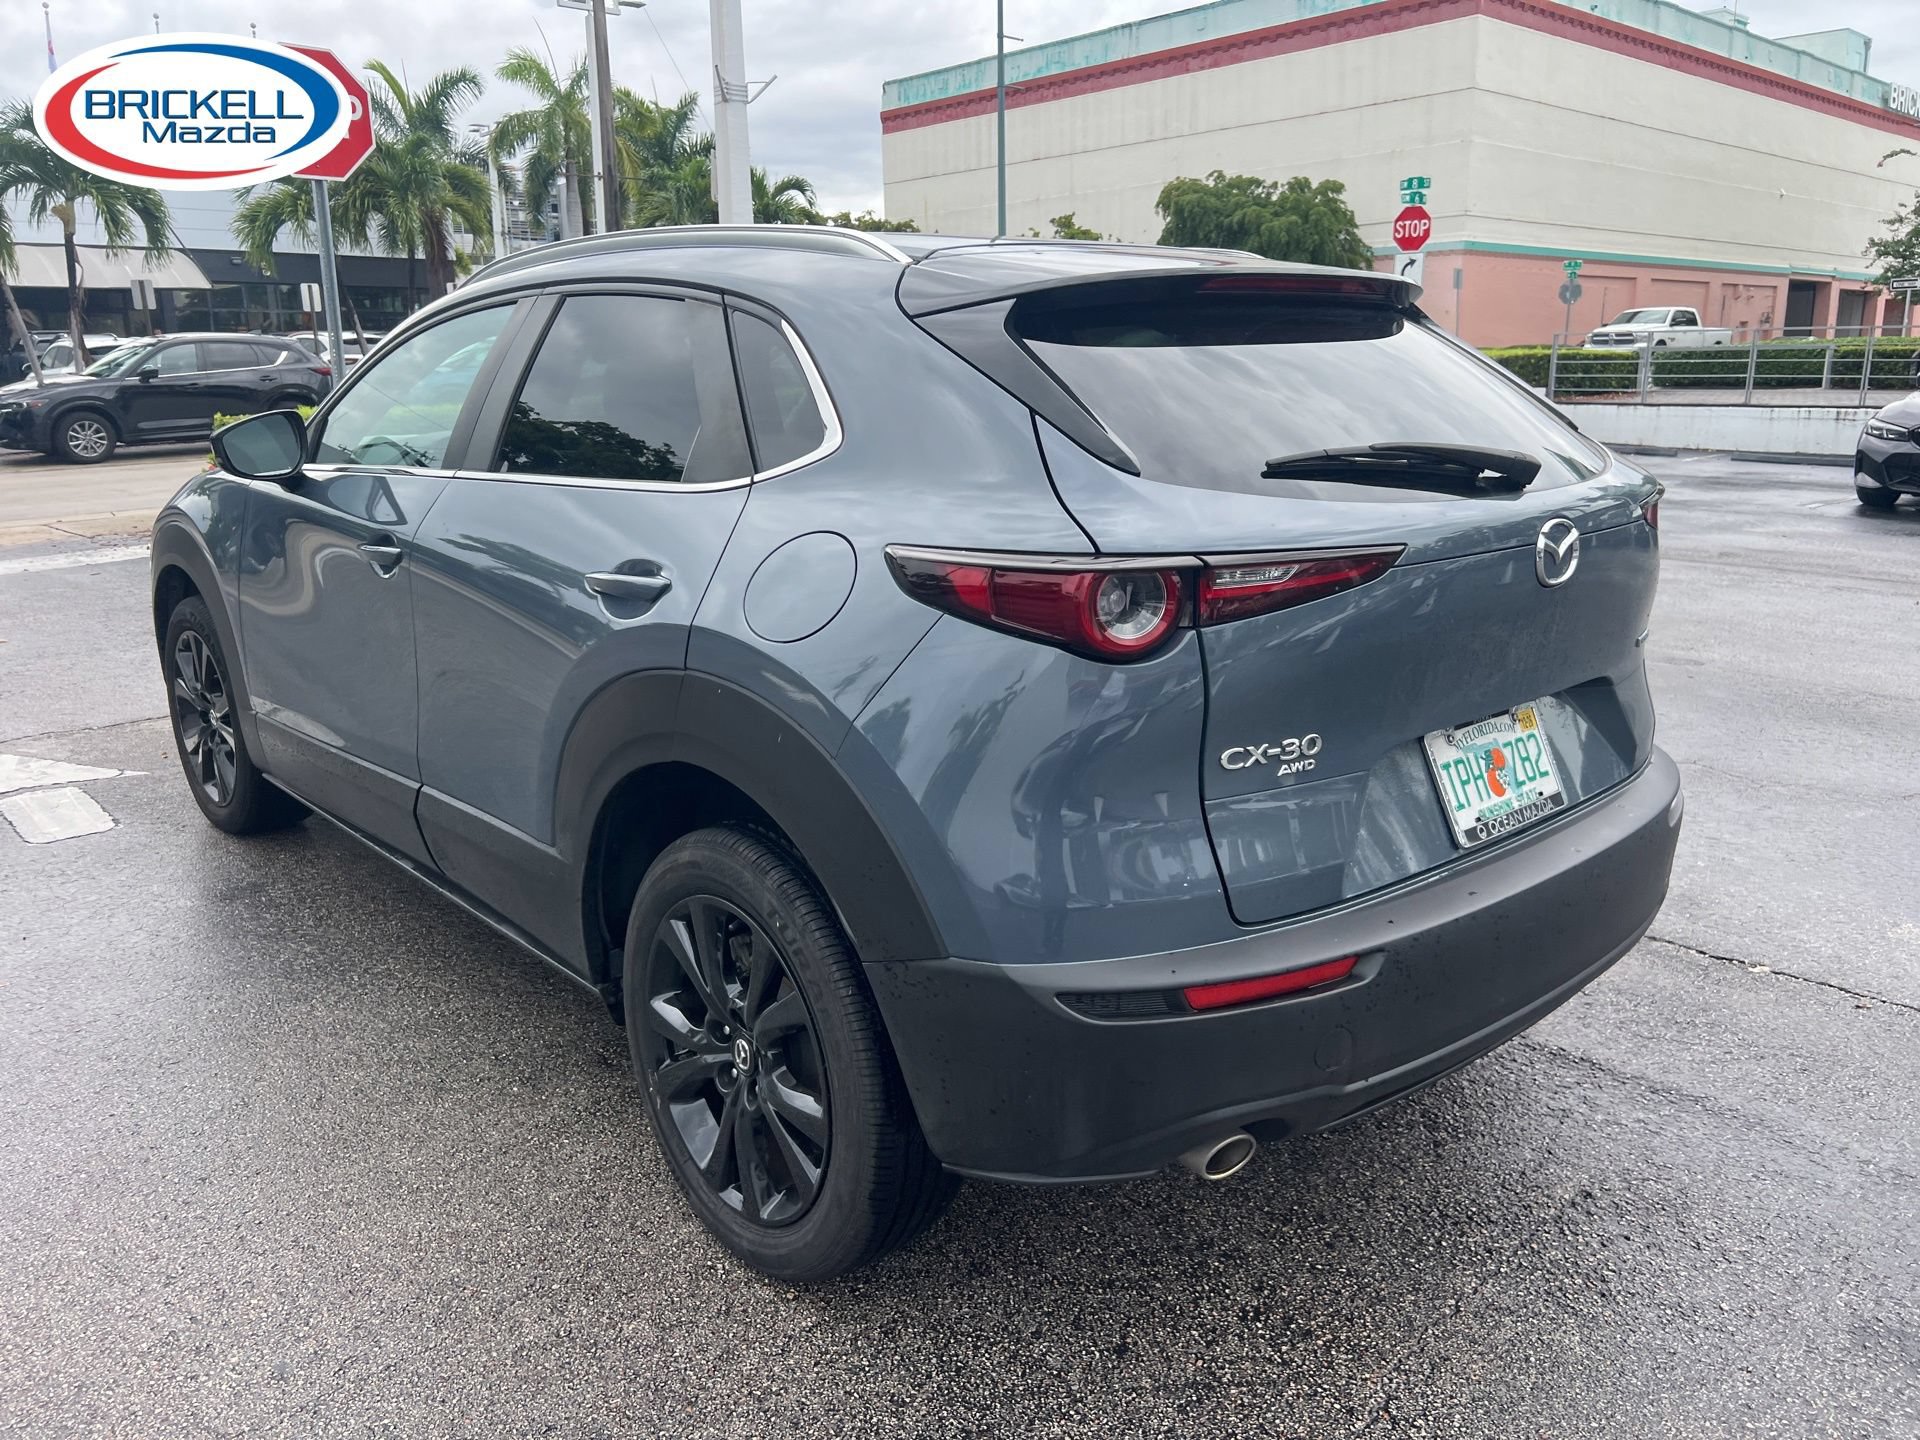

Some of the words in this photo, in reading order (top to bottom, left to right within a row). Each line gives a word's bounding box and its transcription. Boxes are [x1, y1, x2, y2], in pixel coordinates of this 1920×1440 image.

[1395, 219, 1429, 238] STOP
[1220, 733, 1323, 770] CX-30
[1453, 721, 1516, 752] MYFLORIDA.COM
[1277, 758, 1316, 777] AWD
[1488, 813, 1523, 834] OCEAN
[1523, 799, 1554, 822] MAZDA
